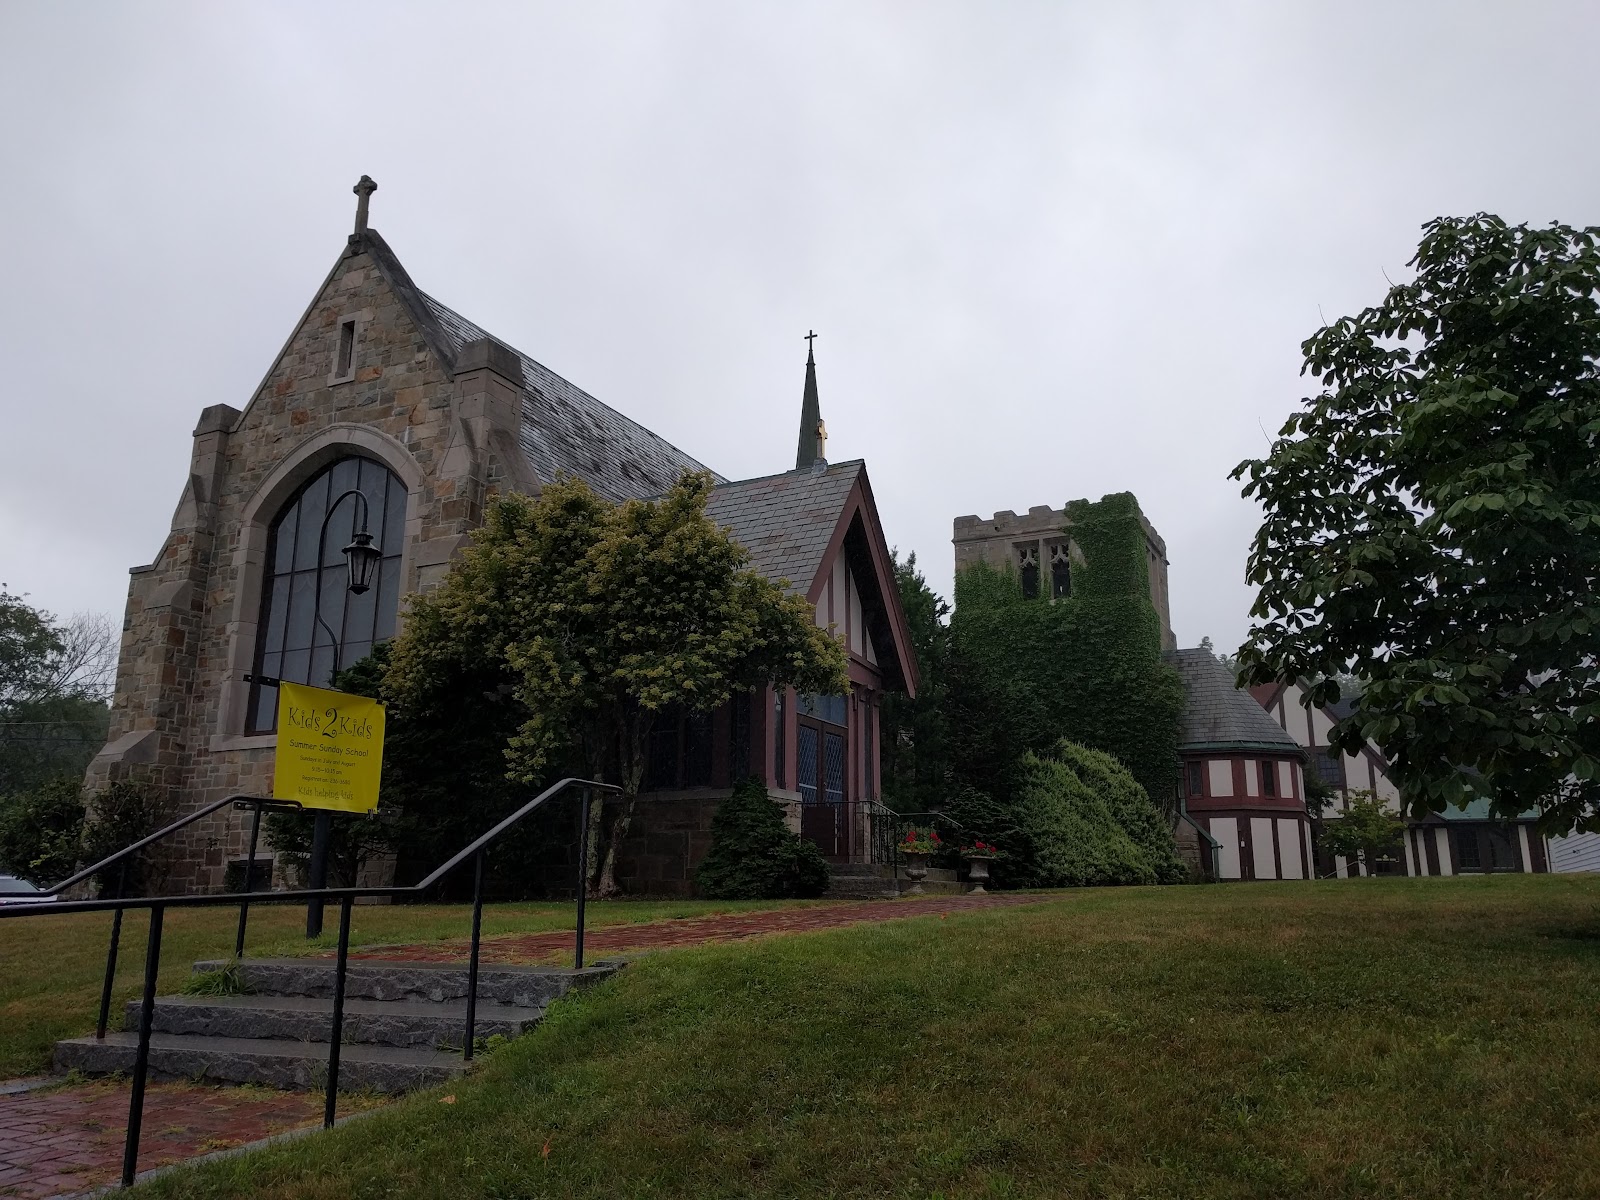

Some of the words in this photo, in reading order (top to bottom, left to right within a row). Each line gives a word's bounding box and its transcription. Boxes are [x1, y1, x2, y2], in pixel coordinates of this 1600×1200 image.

[288, 707, 320, 731] Kids
[322, 707, 338, 739] 2
[338, 716, 372, 739] Kids
[289, 739, 317, 750] Summer
[319, 743, 343, 756] Sunday
[345, 747, 369, 757] School
[300, 755, 317, 763] Sundays
[299, 786, 312, 796] Kids
[314, 786, 340, 800] helping
[340, 789, 354, 801] kids
